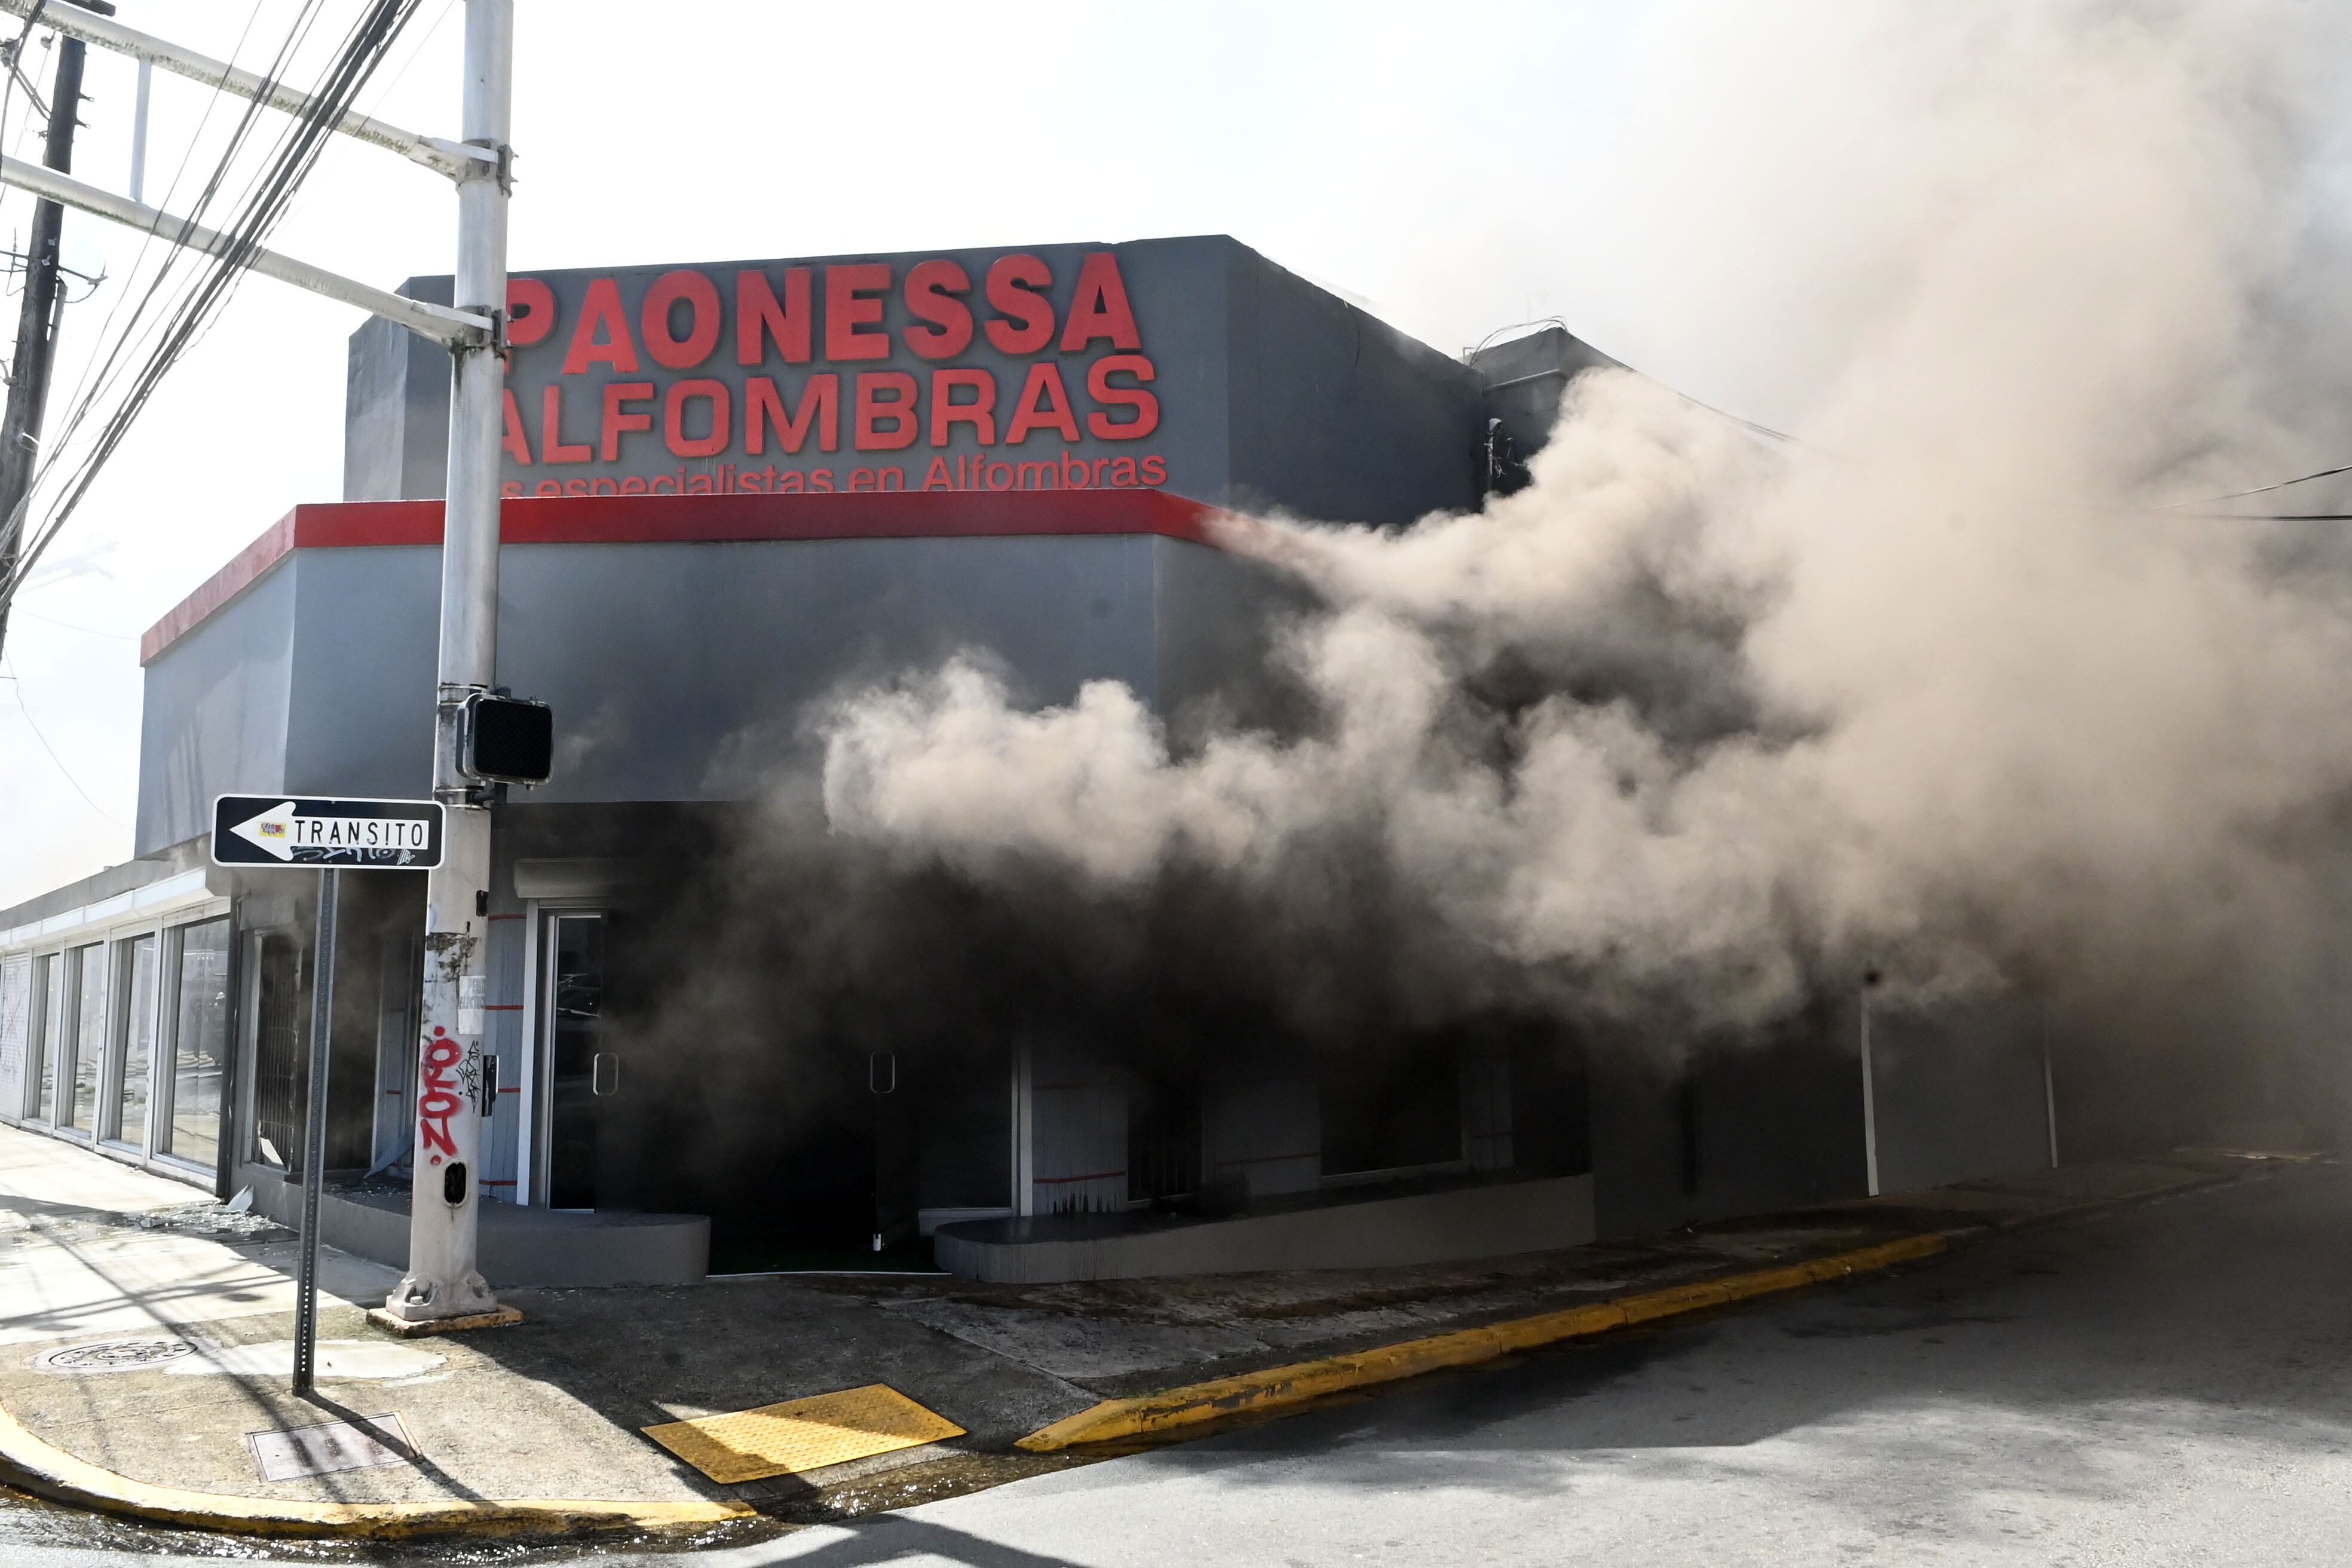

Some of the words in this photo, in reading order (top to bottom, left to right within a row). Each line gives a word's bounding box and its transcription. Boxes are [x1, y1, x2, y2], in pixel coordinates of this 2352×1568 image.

[504, 252, 1143, 375] PAONESSA
[849, 466, 904, 492] en
[922, 451, 1166, 491] Alfombras
[295, 819, 423, 847] TRANSITO
